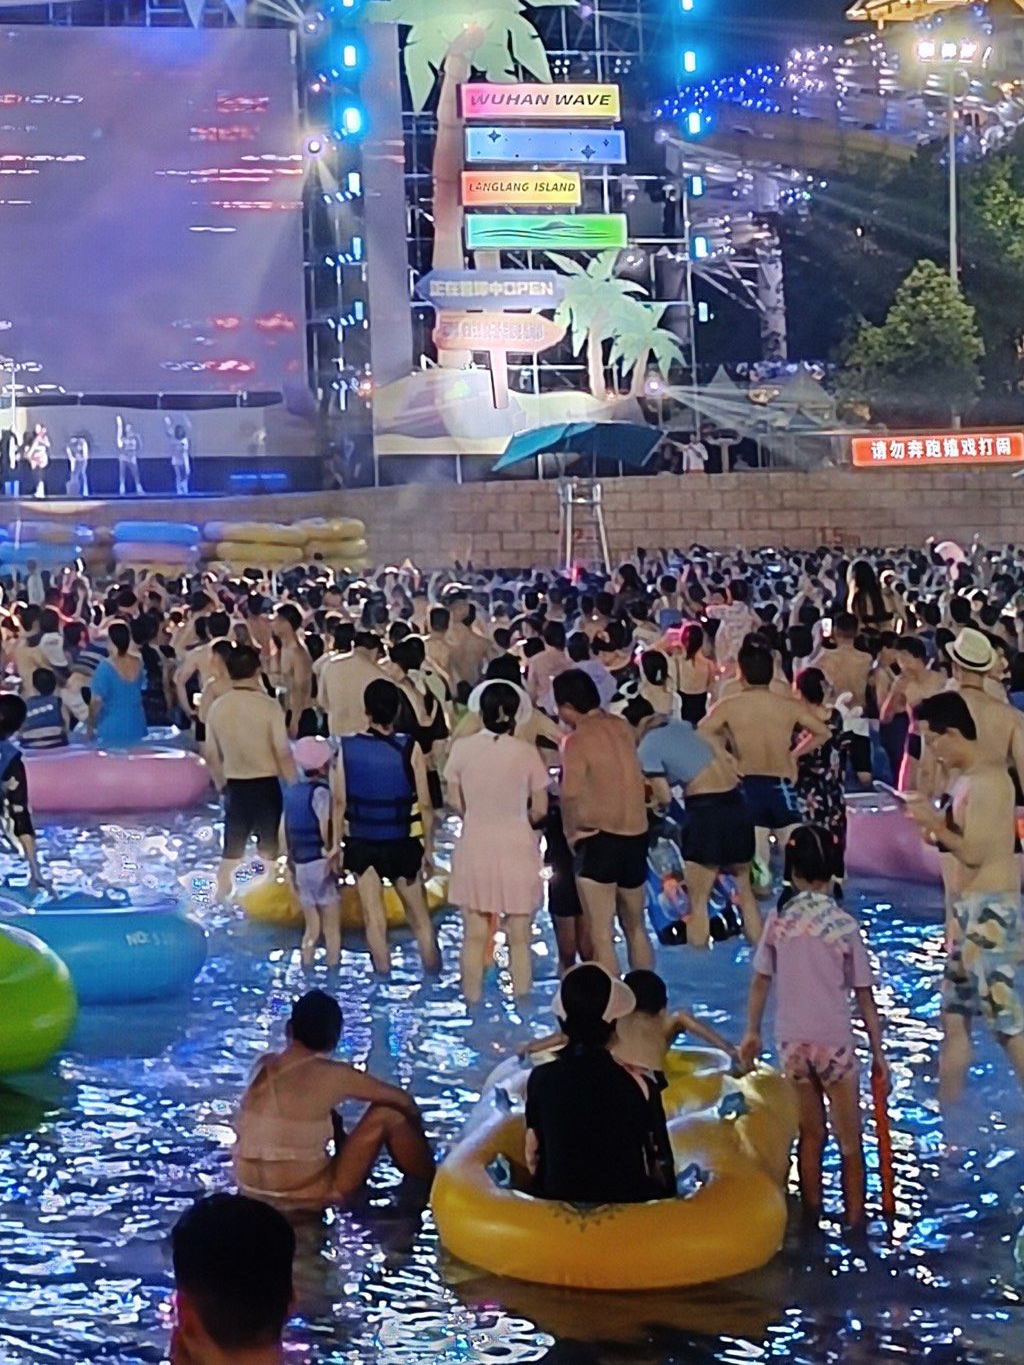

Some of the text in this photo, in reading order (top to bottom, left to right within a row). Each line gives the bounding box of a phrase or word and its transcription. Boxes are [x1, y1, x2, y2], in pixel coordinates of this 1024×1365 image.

[470, 94, 612, 106] WUHAN WAVE
[533, 182, 576, 192] ISLAND
